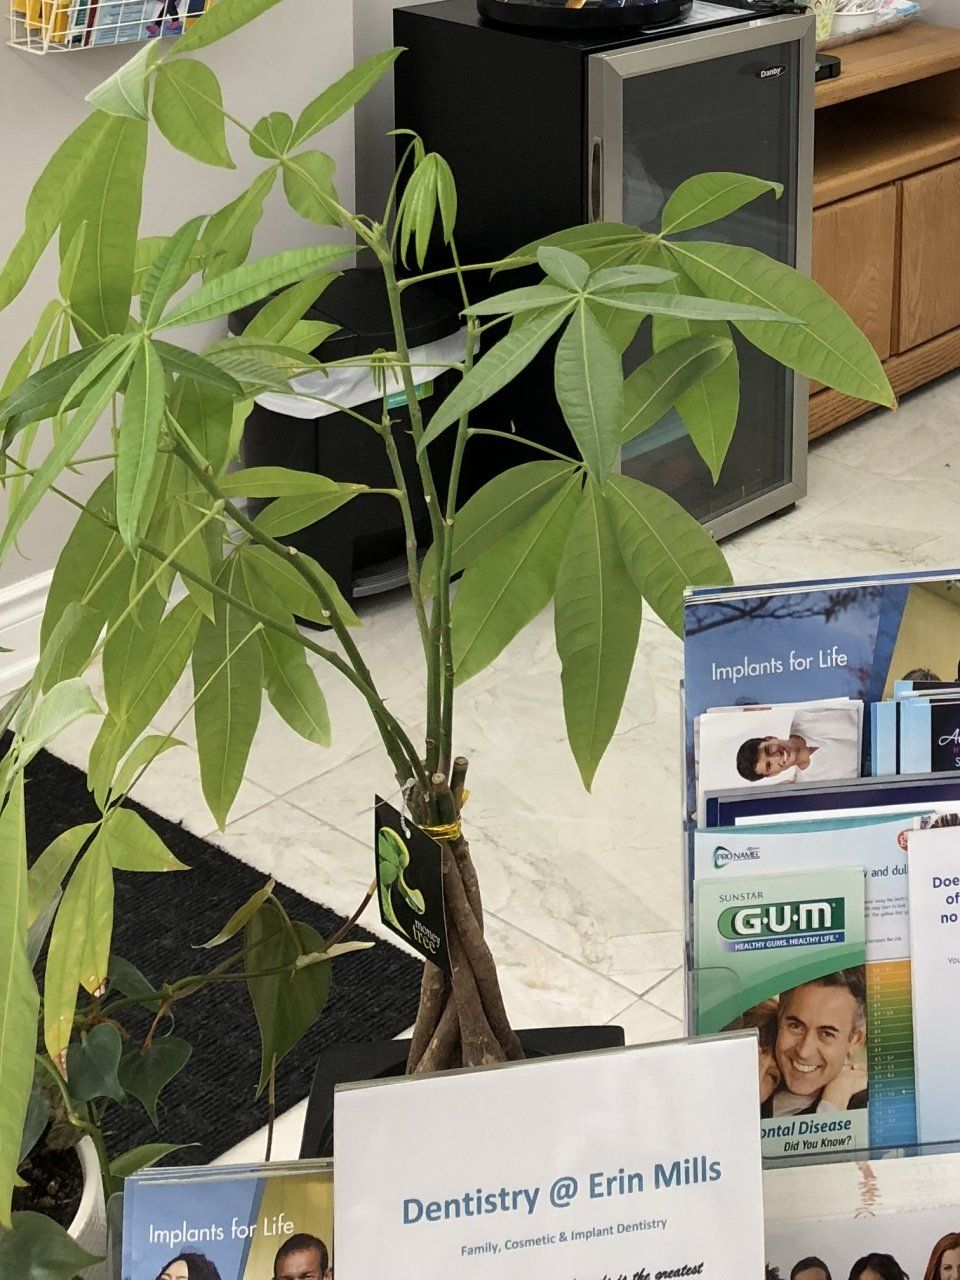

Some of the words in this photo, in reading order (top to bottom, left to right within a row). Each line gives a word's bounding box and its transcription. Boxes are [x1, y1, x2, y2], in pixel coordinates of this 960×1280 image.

[760, 67, 782, 78] Danby
[711, 656, 783, 684] Implants
[789, 650, 814, 671] for
[819, 645, 848, 668] Life
[871, 865, 889, 878] and
[719, 891, 764, 902] SUNSTAR
[940, 913, 958, 924] no
[412, 924, 437, 954] tree
[414, 919, 440, 948] money
[735, 941, 765, 951] HEALTHY
[766, 938, 789, 948] GUMS.
[789, 935, 820, 946] HEALTHY
[798, 1119, 851, 1135] Disease
[784, 1141, 800, 1153] Did
[802, 1139, 819, 1151] You
[820, 1135, 852, 1149] Know?
[403, 1187, 540, 1224] Dentistry
[549, 1176, 578, 1208] @
[589, 1168, 644, 1199] Erin
[653, 1155, 721, 1190] Mills
[149, 1220, 224, 1248] Implants
[231, 1217, 257, 1239] for
[263, 1213, 295, 1236] Life
[461, 1240, 502, 1256] Family,
[505, 1233, 556, 1251] Cosmetic
[559, 1231, 568, 1243] &
[571, 1225, 614, 1242] Implant
[616, 1218, 668, 1234] Dentistry
[655, 1261, 704, 1280] greatest
